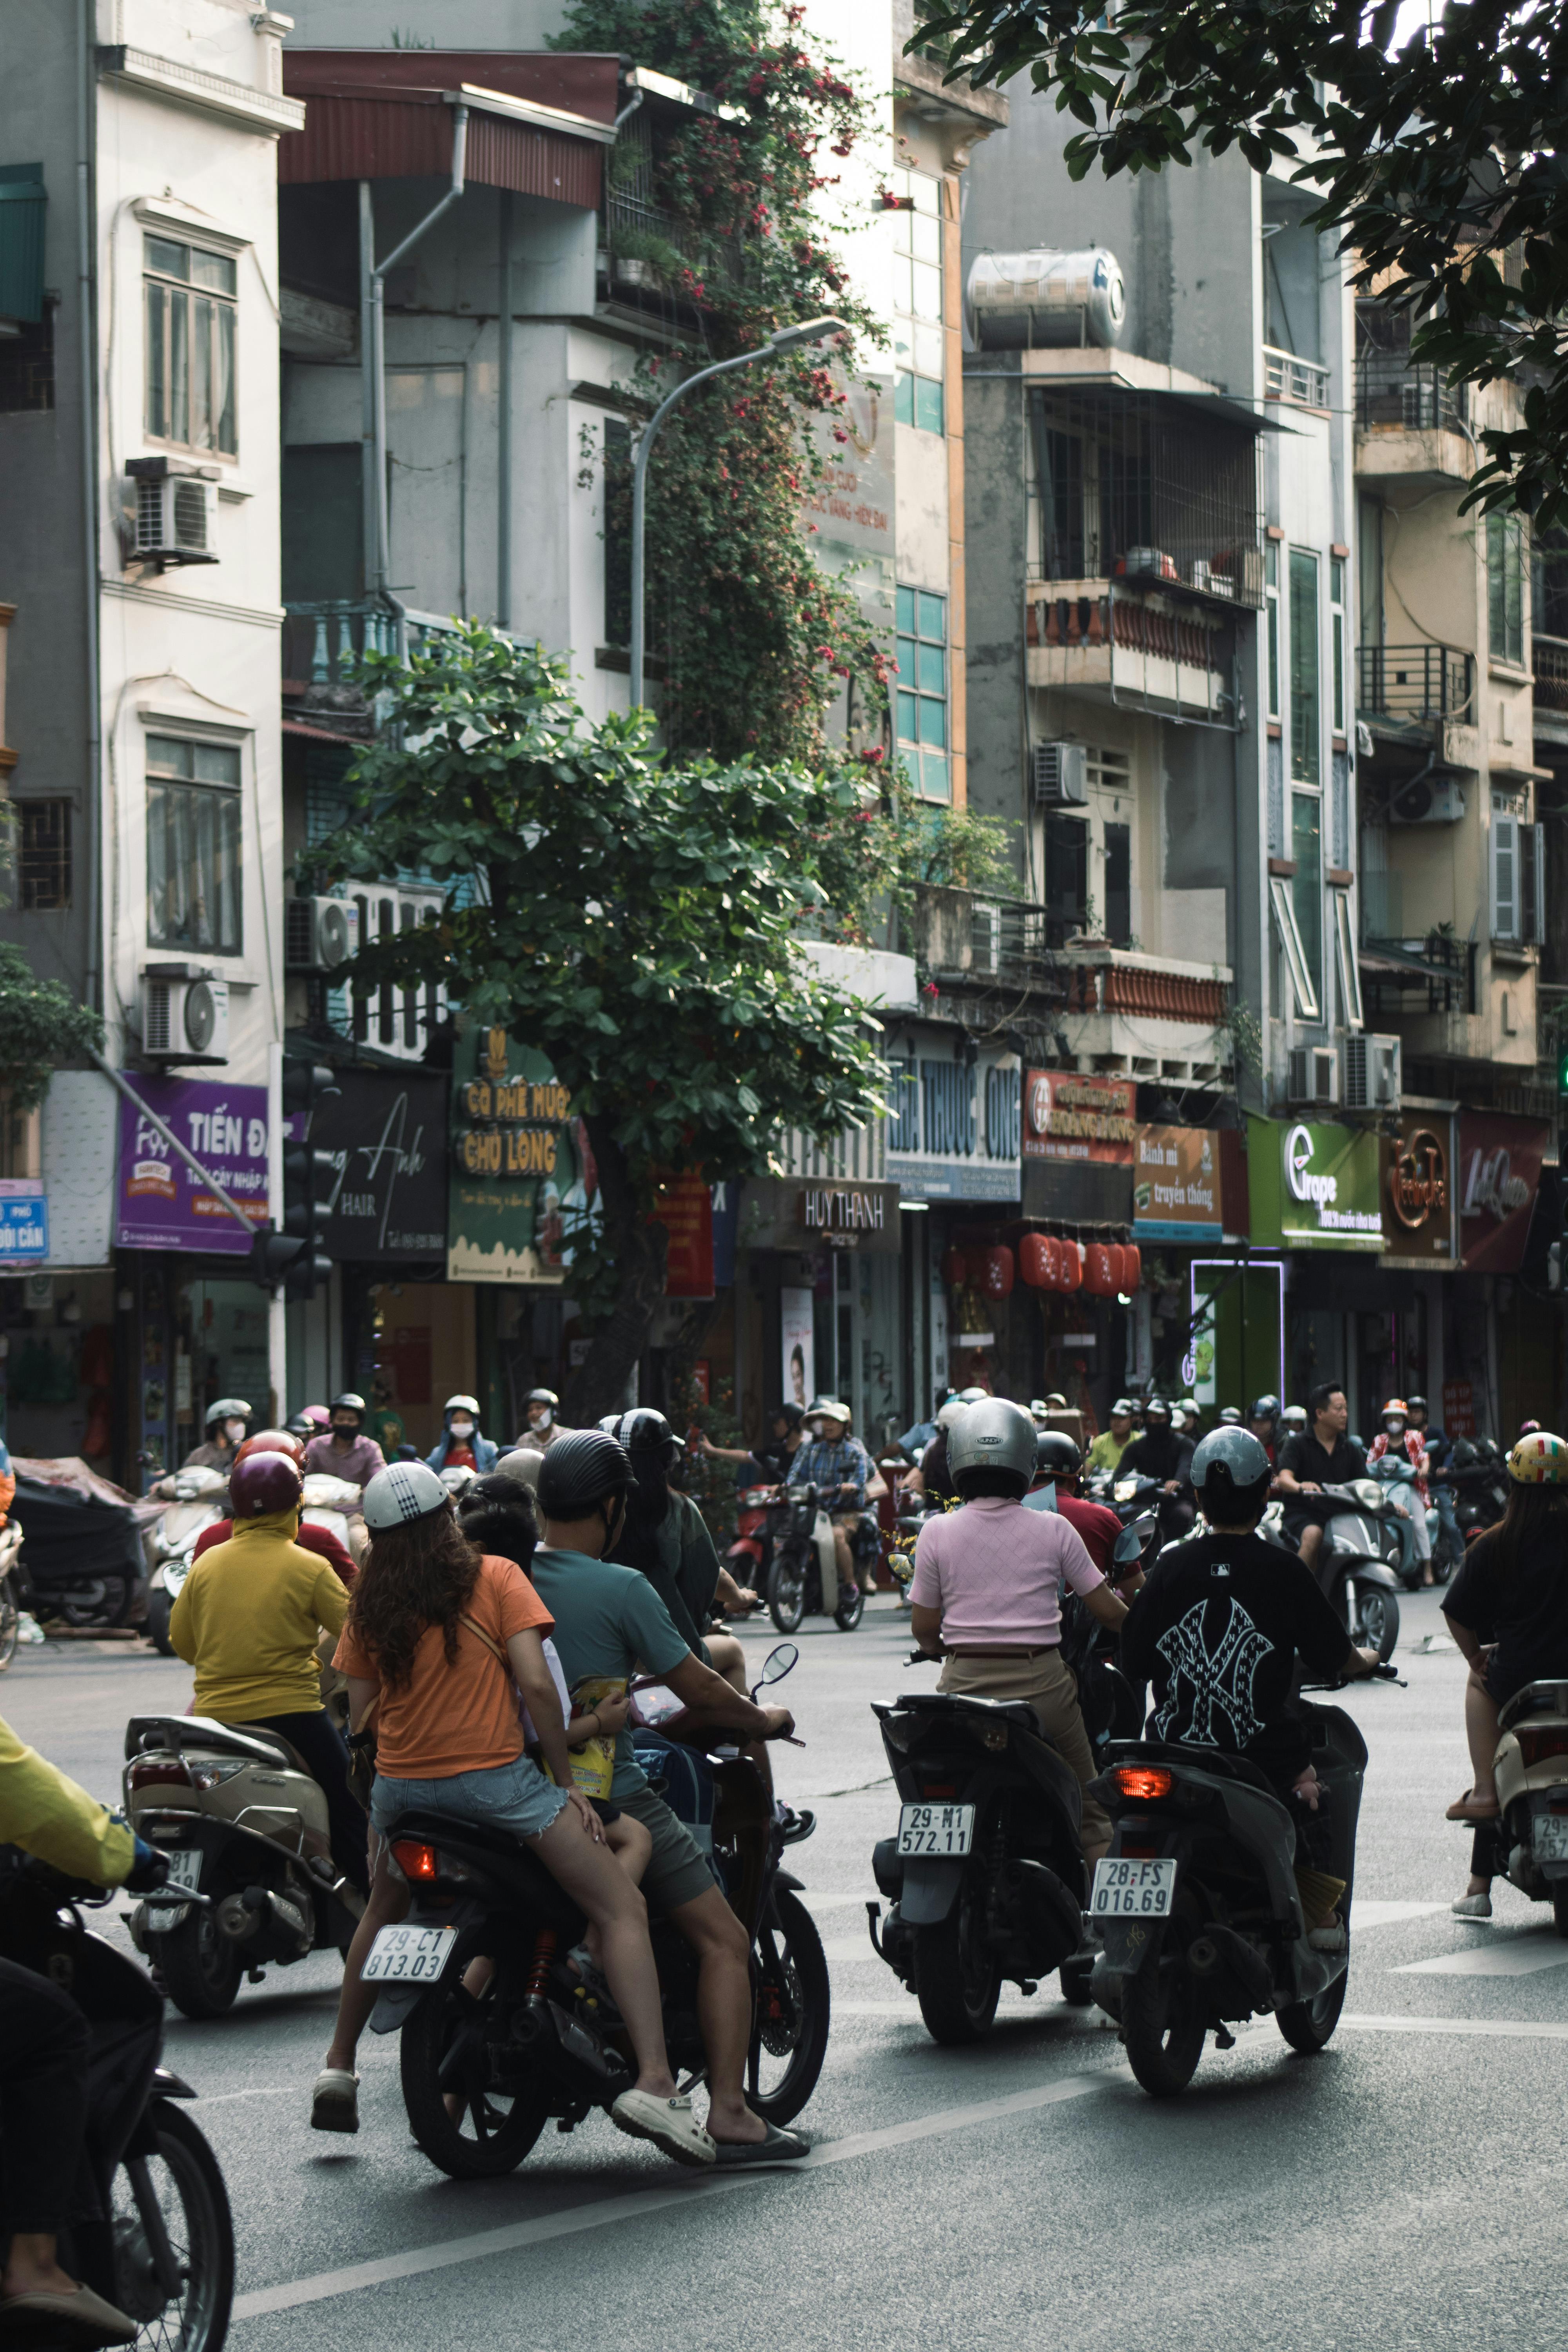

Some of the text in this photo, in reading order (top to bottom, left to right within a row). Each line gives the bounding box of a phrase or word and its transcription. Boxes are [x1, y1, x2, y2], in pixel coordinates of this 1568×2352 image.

[532, 1077, 571, 1123] MUỐ
[188, 1102, 242, 1156] TIẾN
[506, 1130, 557, 1174] LONG
[1139, 1139, 1163, 1165] Bánh
[1285, 1124, 1337, 1210] Grape
[341, 1193, 376, 1217] HAIR
[805, 1190, 884, 1229] HUY THANH
[18, 1221, 44, 1248] CẤN
[910, 1807, 962, 1829] 29-M1
[902, 1831, 967, 1852] 572.11
[1106, 1863, 1163, 1887] 28-FS
[1096, 1889, 1167, 1913] 016.69
[383, 1930, 443, 1952] 29-C1
[367, 1955, 441, 1977] 813.03
